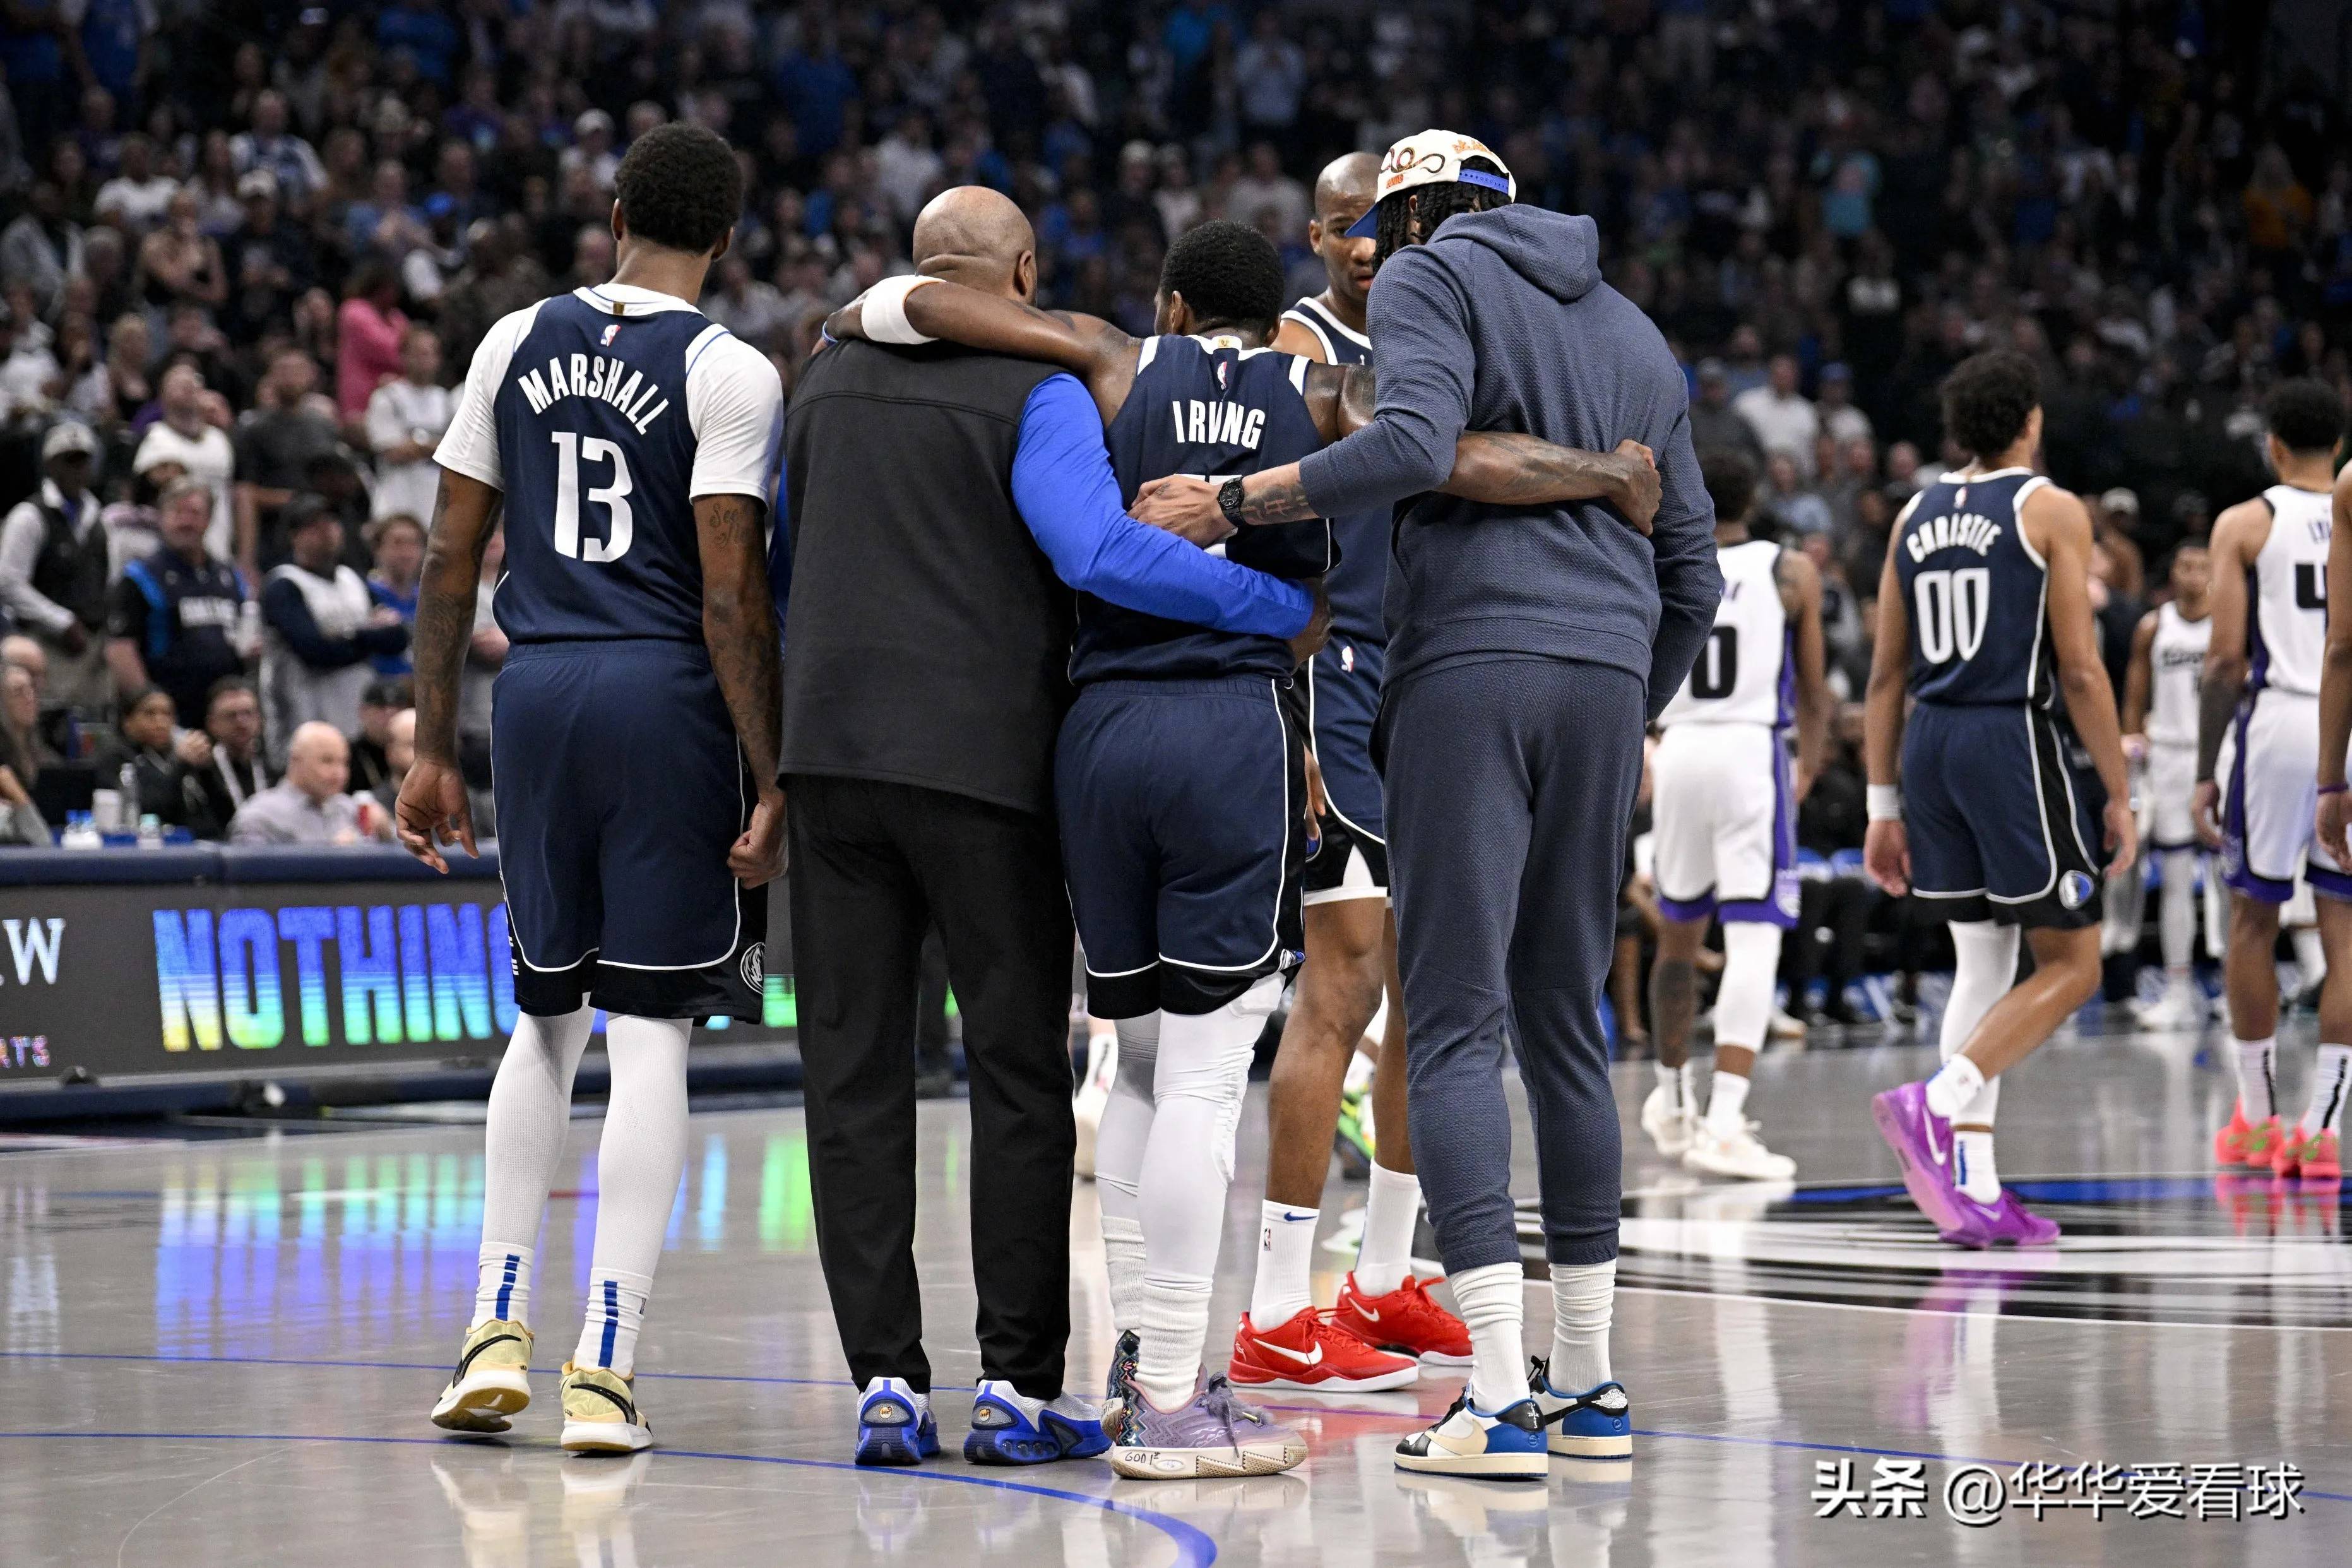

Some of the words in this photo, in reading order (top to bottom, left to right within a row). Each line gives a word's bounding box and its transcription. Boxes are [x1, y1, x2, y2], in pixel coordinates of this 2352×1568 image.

[518, 353, 669, 435] MARSHALL
[551, 431, 633, 562] 13
[1906, 513, 2002, 563] CHRISTIE
[1914, 567, 1990, 664] 00
